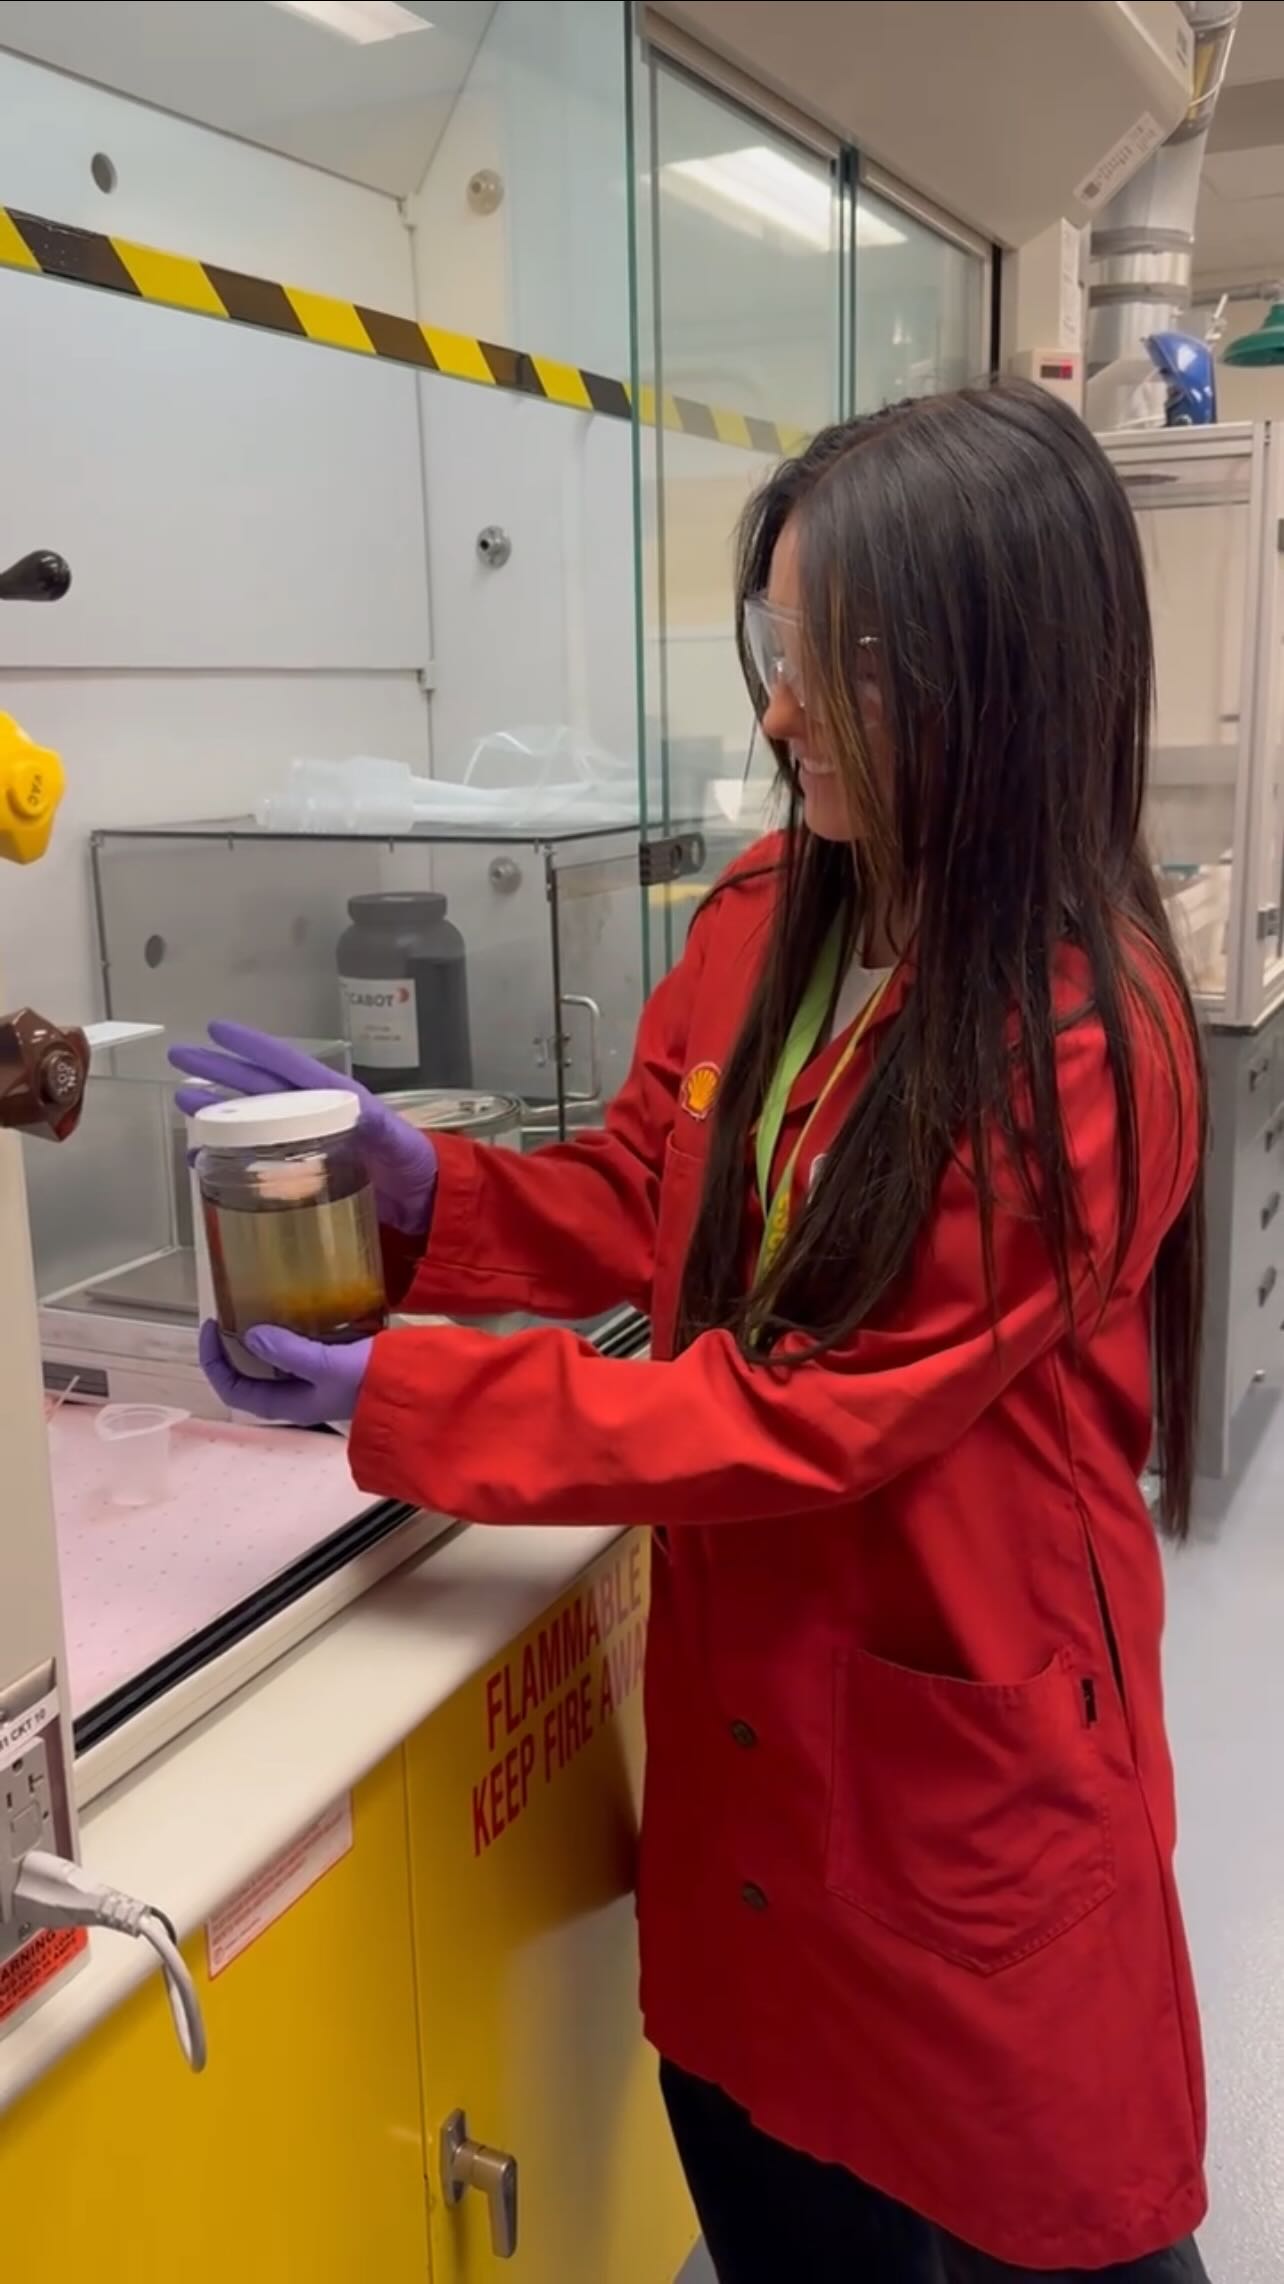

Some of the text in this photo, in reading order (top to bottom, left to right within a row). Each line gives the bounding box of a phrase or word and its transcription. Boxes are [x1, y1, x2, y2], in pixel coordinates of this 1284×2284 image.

[485, 1544, 642, 1752] FLAMMABLE
[10, 1718, 32, 1741] CKT
[472, 1620, 646, 1857] KEEP FIRE AWA
[0, 1927, 56, 1981] ARNING
